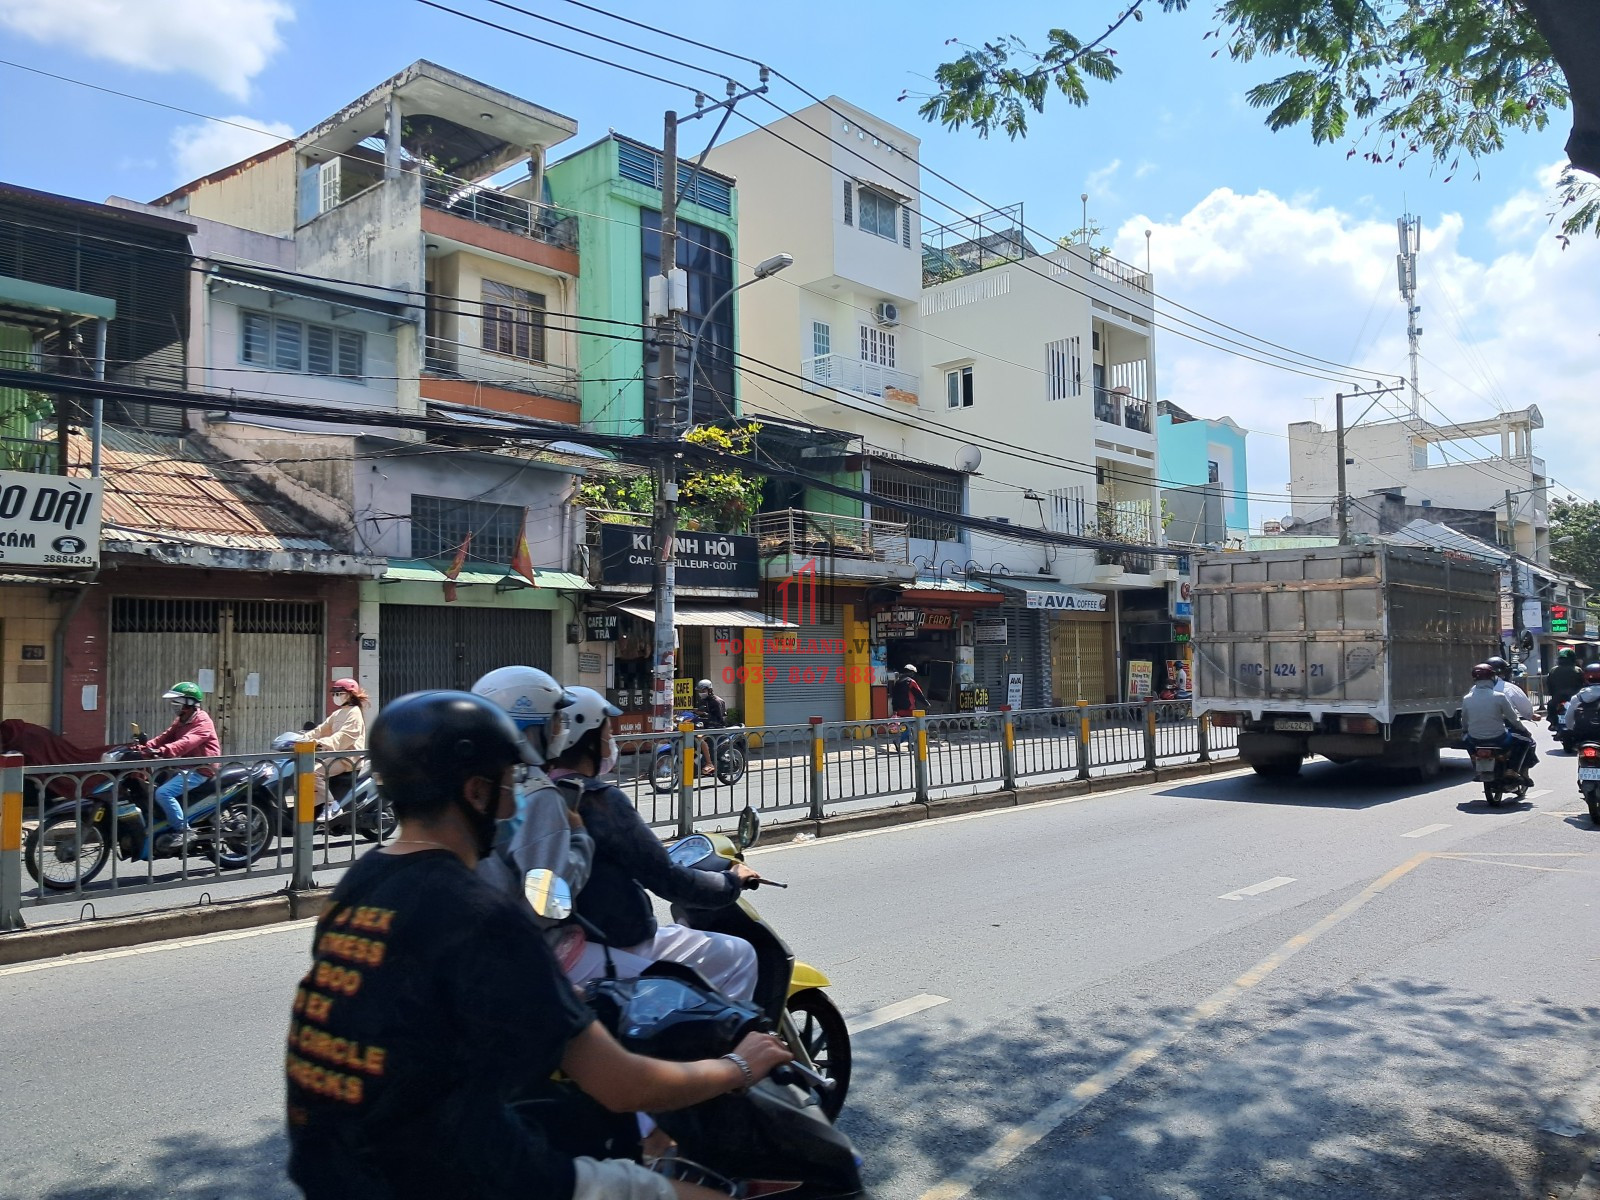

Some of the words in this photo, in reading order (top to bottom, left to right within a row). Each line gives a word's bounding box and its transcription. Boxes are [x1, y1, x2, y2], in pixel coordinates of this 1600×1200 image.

[0, 474, 27, 519] O
[29, 481, 93, 530] DÀI
[632, 533, 698, 554] KNH
[705, 537, 735, 559] HỘI
[43, 554, 92, 565] 38884243
[1044, 595, 1076, 609] AVA
[1077, 599, 1098, 609] COFFEE
[1274, 663, 1297, 677] 424
[1310, 663, 1325, 677] 21
[676, 680, 690, 694] CAFÉ
